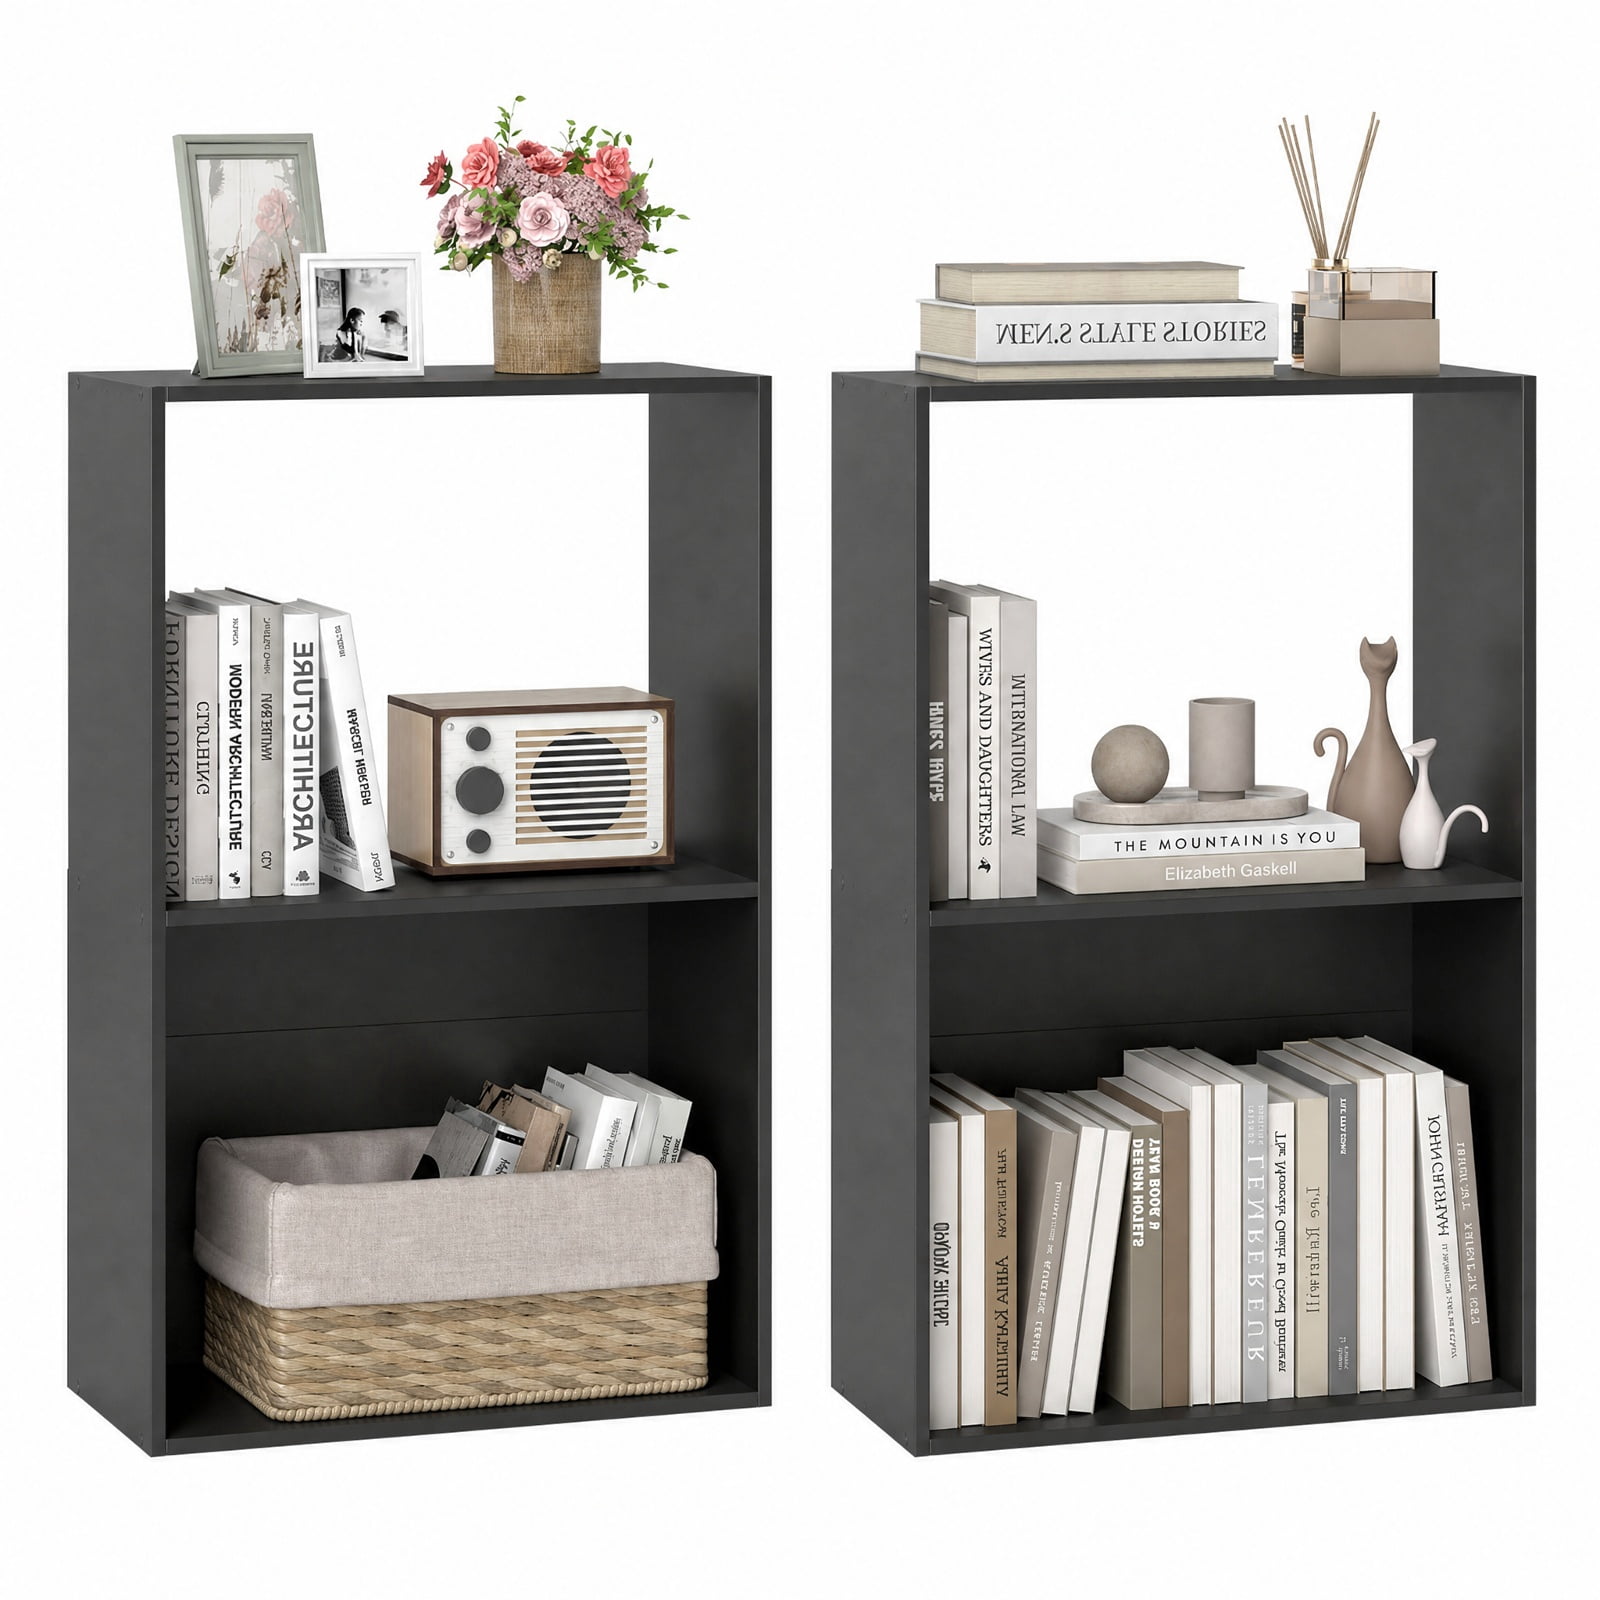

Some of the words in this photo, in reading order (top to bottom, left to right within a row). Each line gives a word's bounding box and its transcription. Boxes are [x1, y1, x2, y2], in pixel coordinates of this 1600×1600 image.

[978, 690, 993, 731] AND
[978, 735, 993, 847] DAUGHTERS
[1010, 803, 1027, 837] LAW
[1114, 839, 1148, 853] THE
[1158, 834, 1264, 851] MOUNTAIN
[1271, 832, 1289, 846] IS
[1296, 830, 1337, 845] YOU
[1165, 865, 1236, 881] Elizabeth
[1240, 860, 1297, 878] Gaskell
